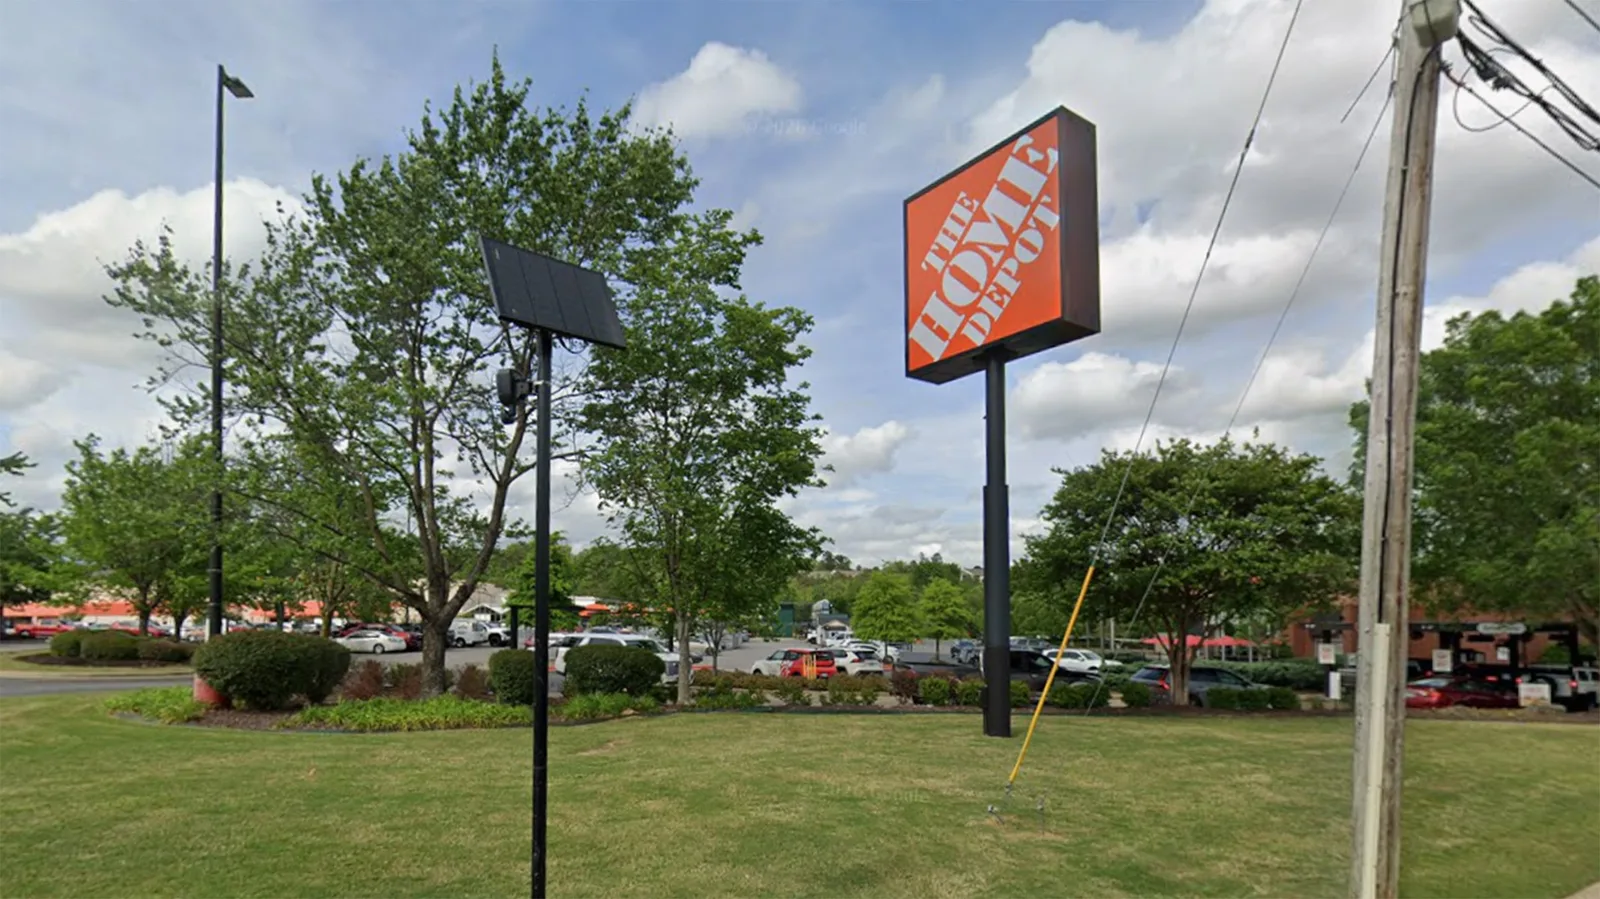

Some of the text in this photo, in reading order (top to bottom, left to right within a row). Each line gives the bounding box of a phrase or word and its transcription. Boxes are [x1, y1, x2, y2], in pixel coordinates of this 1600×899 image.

[908, 134, 1059, 362] HOME
[921, 191, 980, 273] THE
[961, 195, 1060, 346] DEPOT
